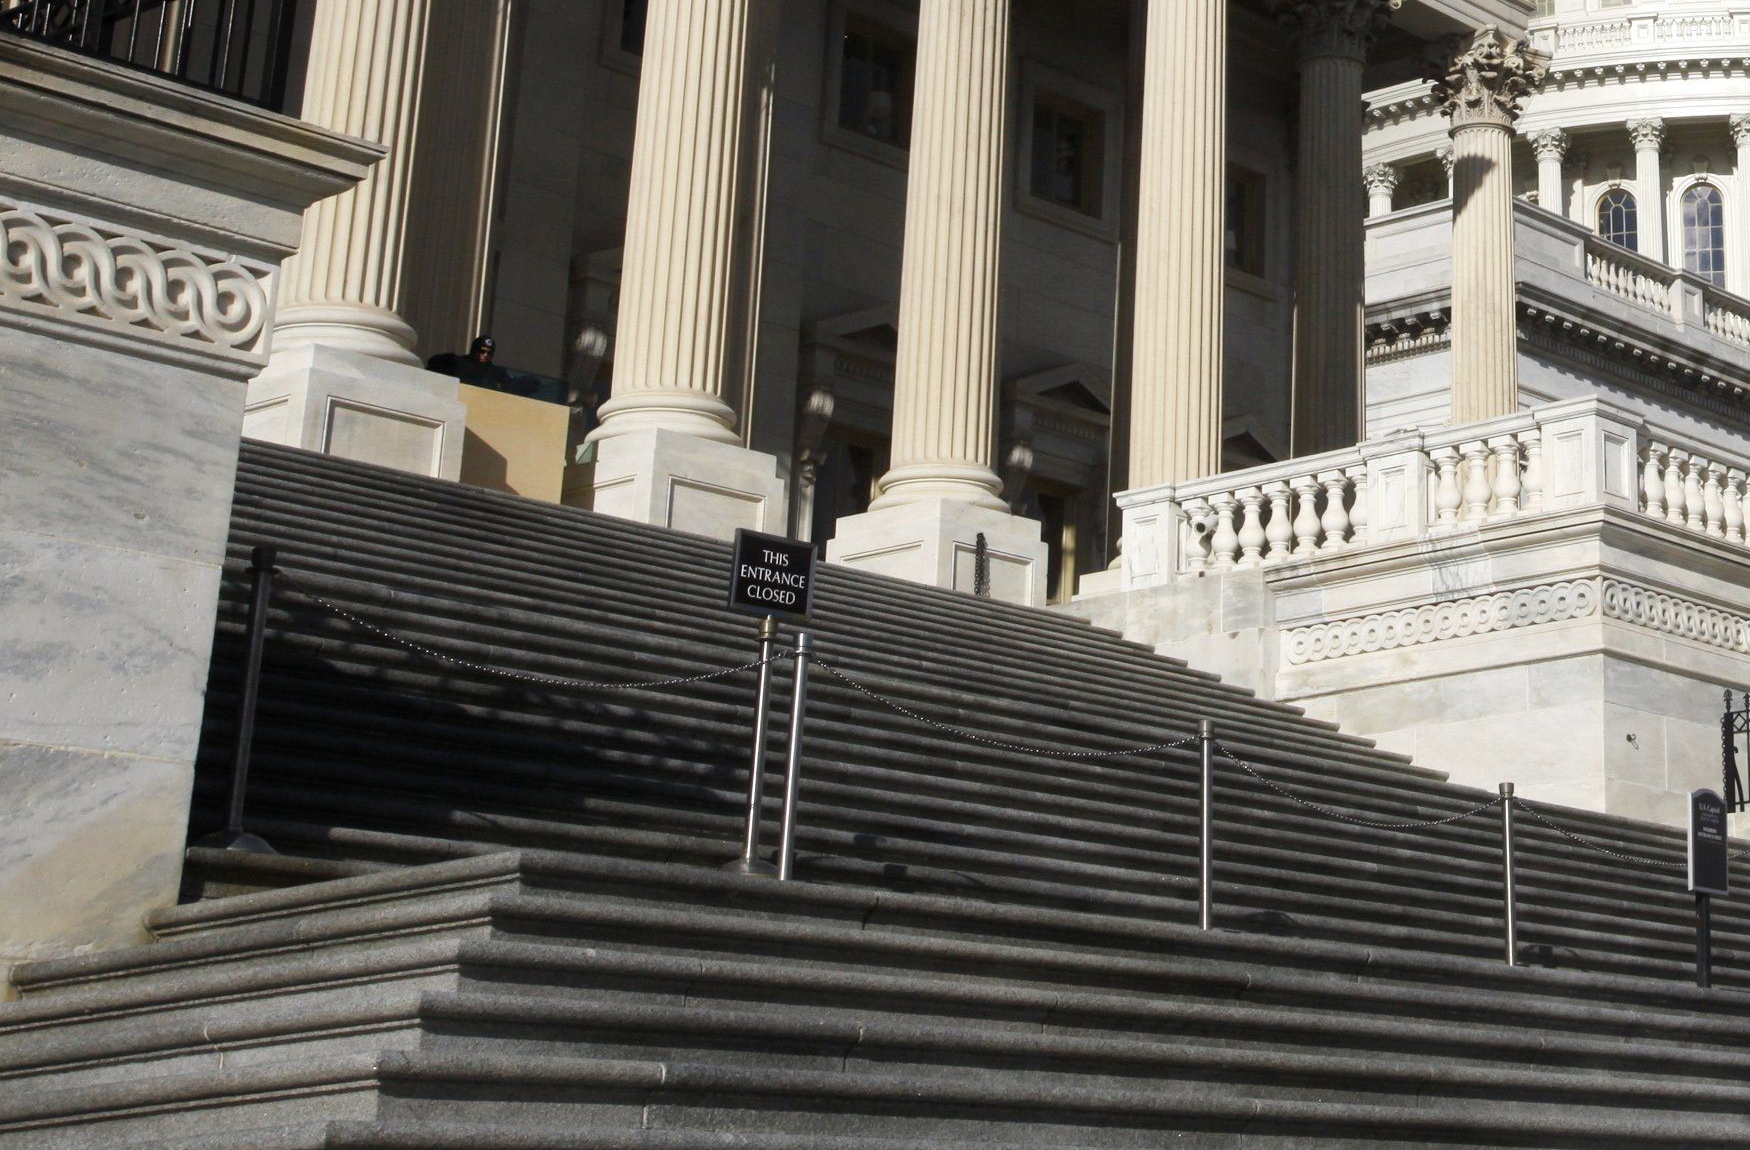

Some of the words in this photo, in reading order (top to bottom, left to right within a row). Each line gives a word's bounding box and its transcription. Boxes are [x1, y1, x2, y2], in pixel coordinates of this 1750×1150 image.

[762, 549, 789, 566] THIS
[740, 564, 805, 588] ENTRANCE
[747, 584, 796, 605] CLOSED
